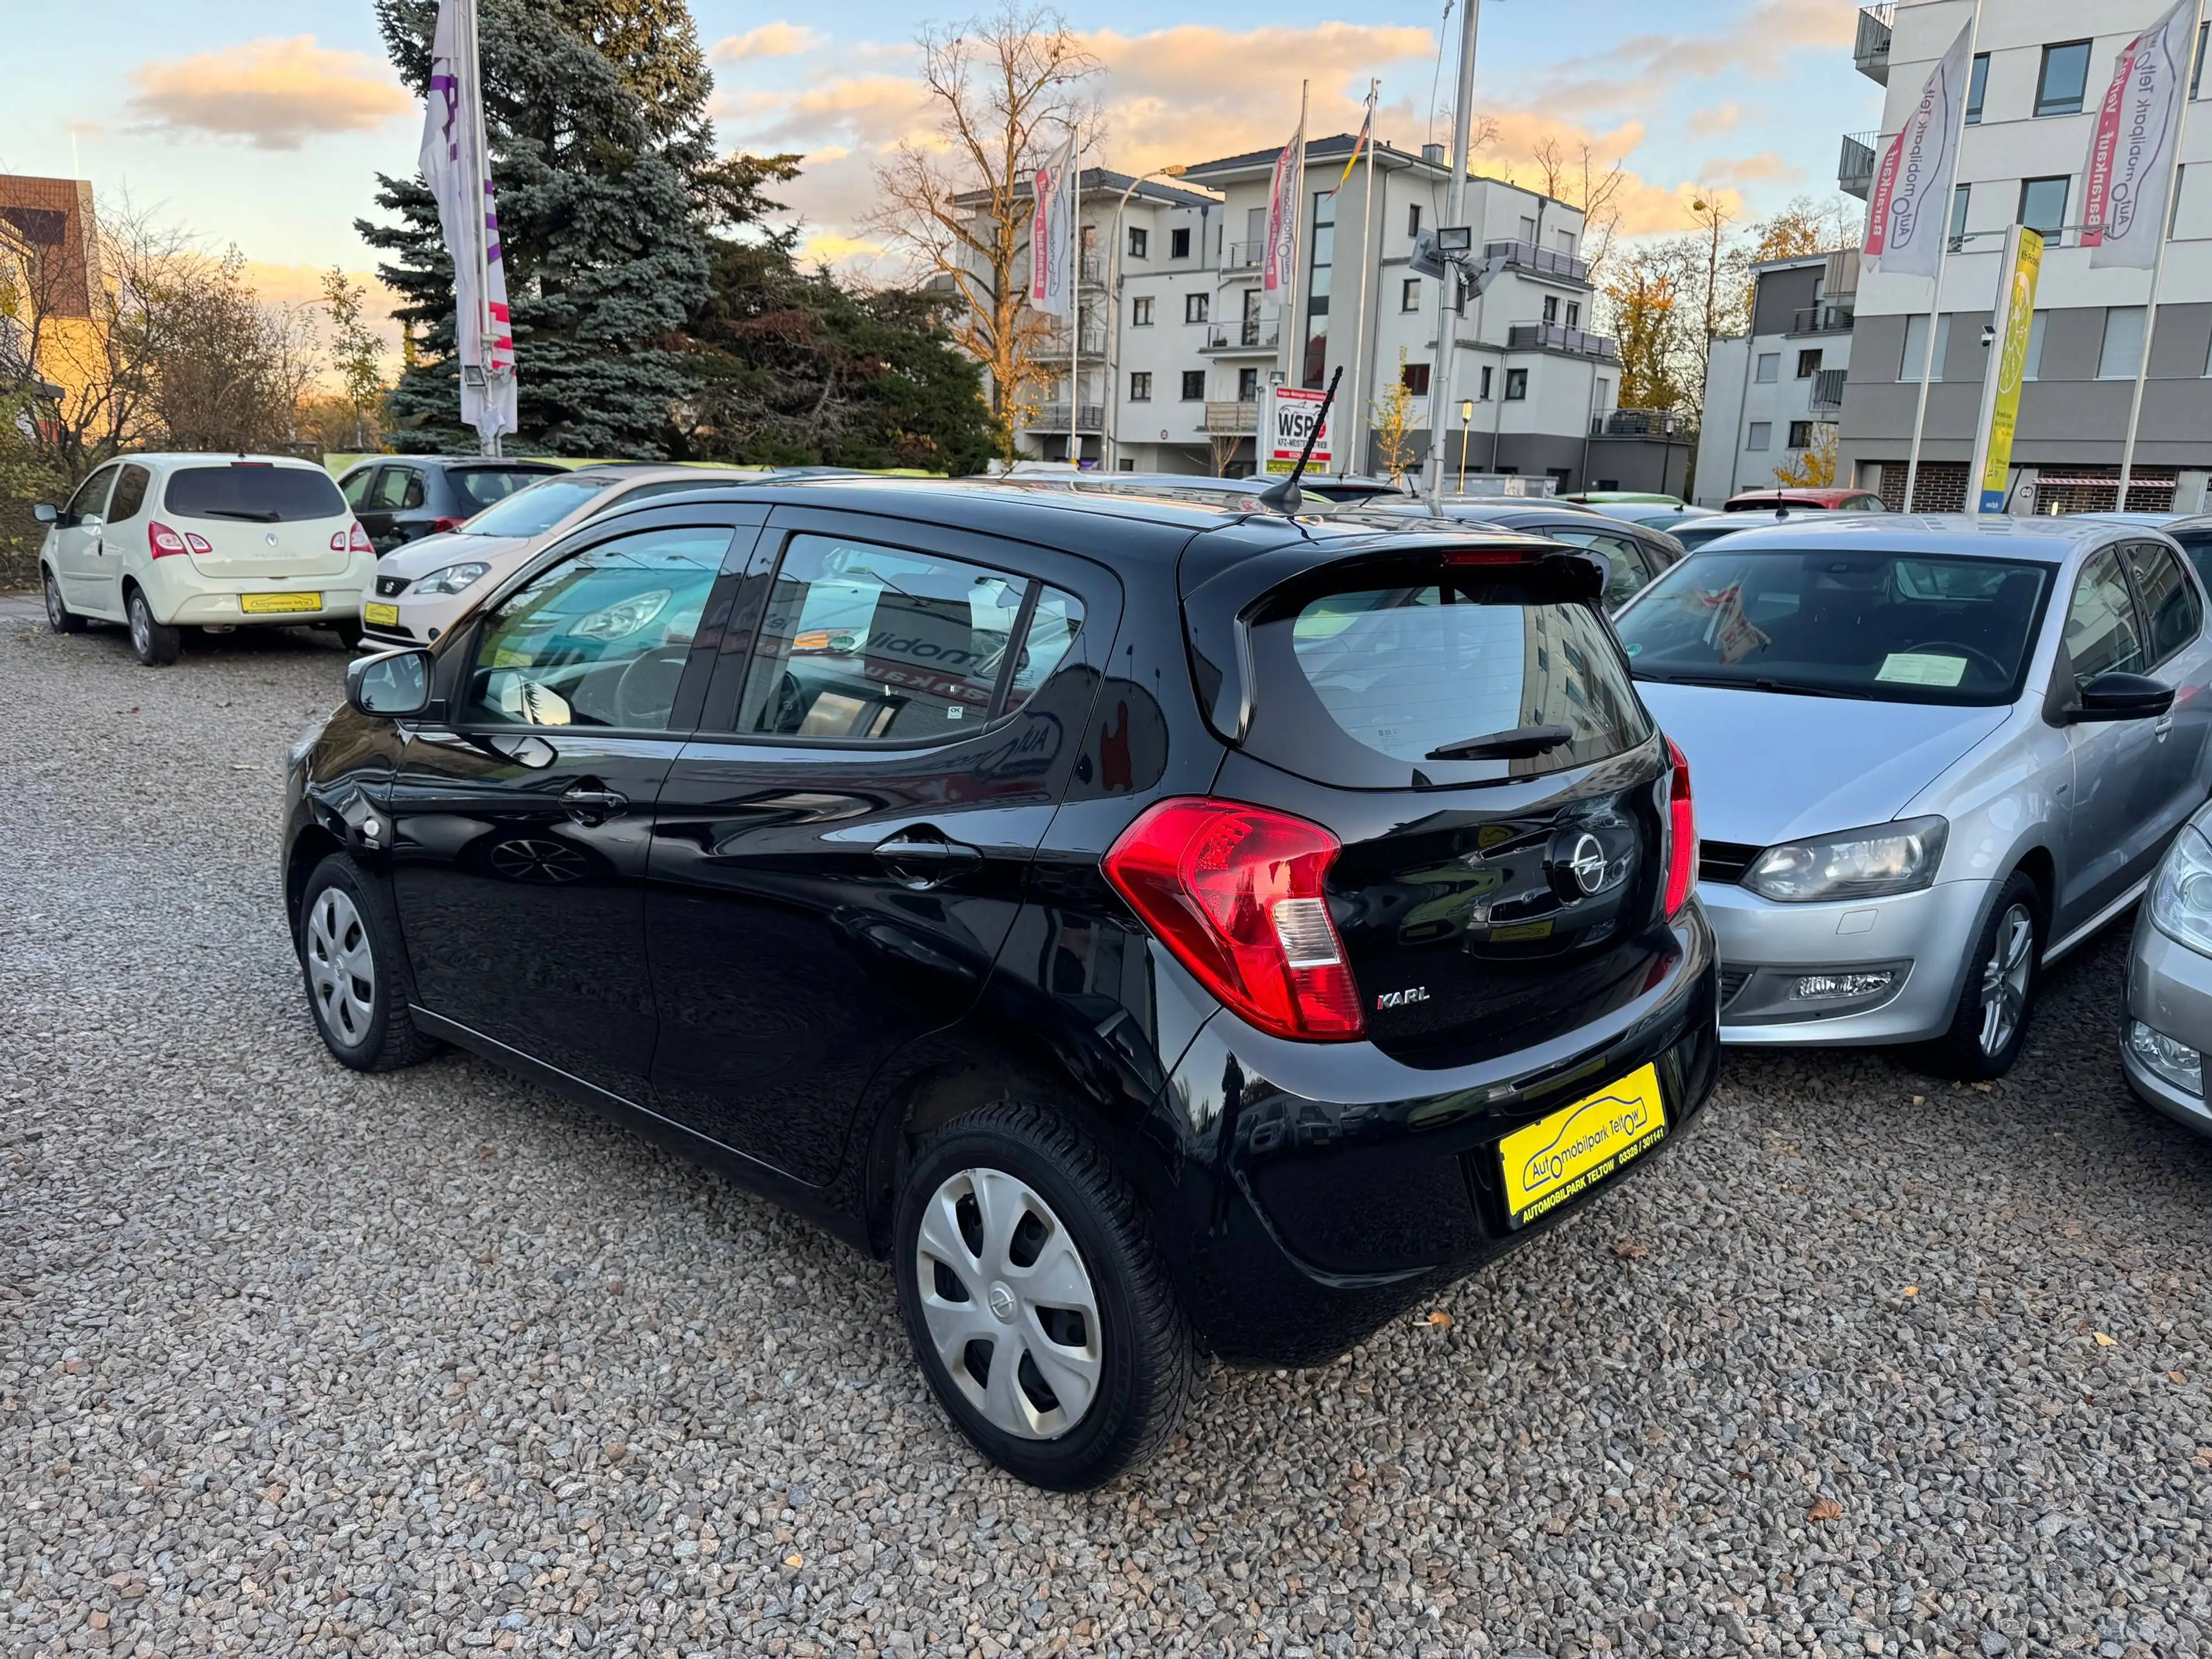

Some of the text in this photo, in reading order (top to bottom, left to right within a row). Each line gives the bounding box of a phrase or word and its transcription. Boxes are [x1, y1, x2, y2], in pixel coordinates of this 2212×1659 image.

[1278, 413, 1313, 438] WSP
[1377, 986, 1430, 1010] KARL
[1523, 1177, 1586, 1223] AUTOMOBILPARK
[1586, 1159, 1614, 1184] TELTOW
[1619, 1146, 1638, 1165] 03328
[1642, 1128, 1664, 1149] 301141
